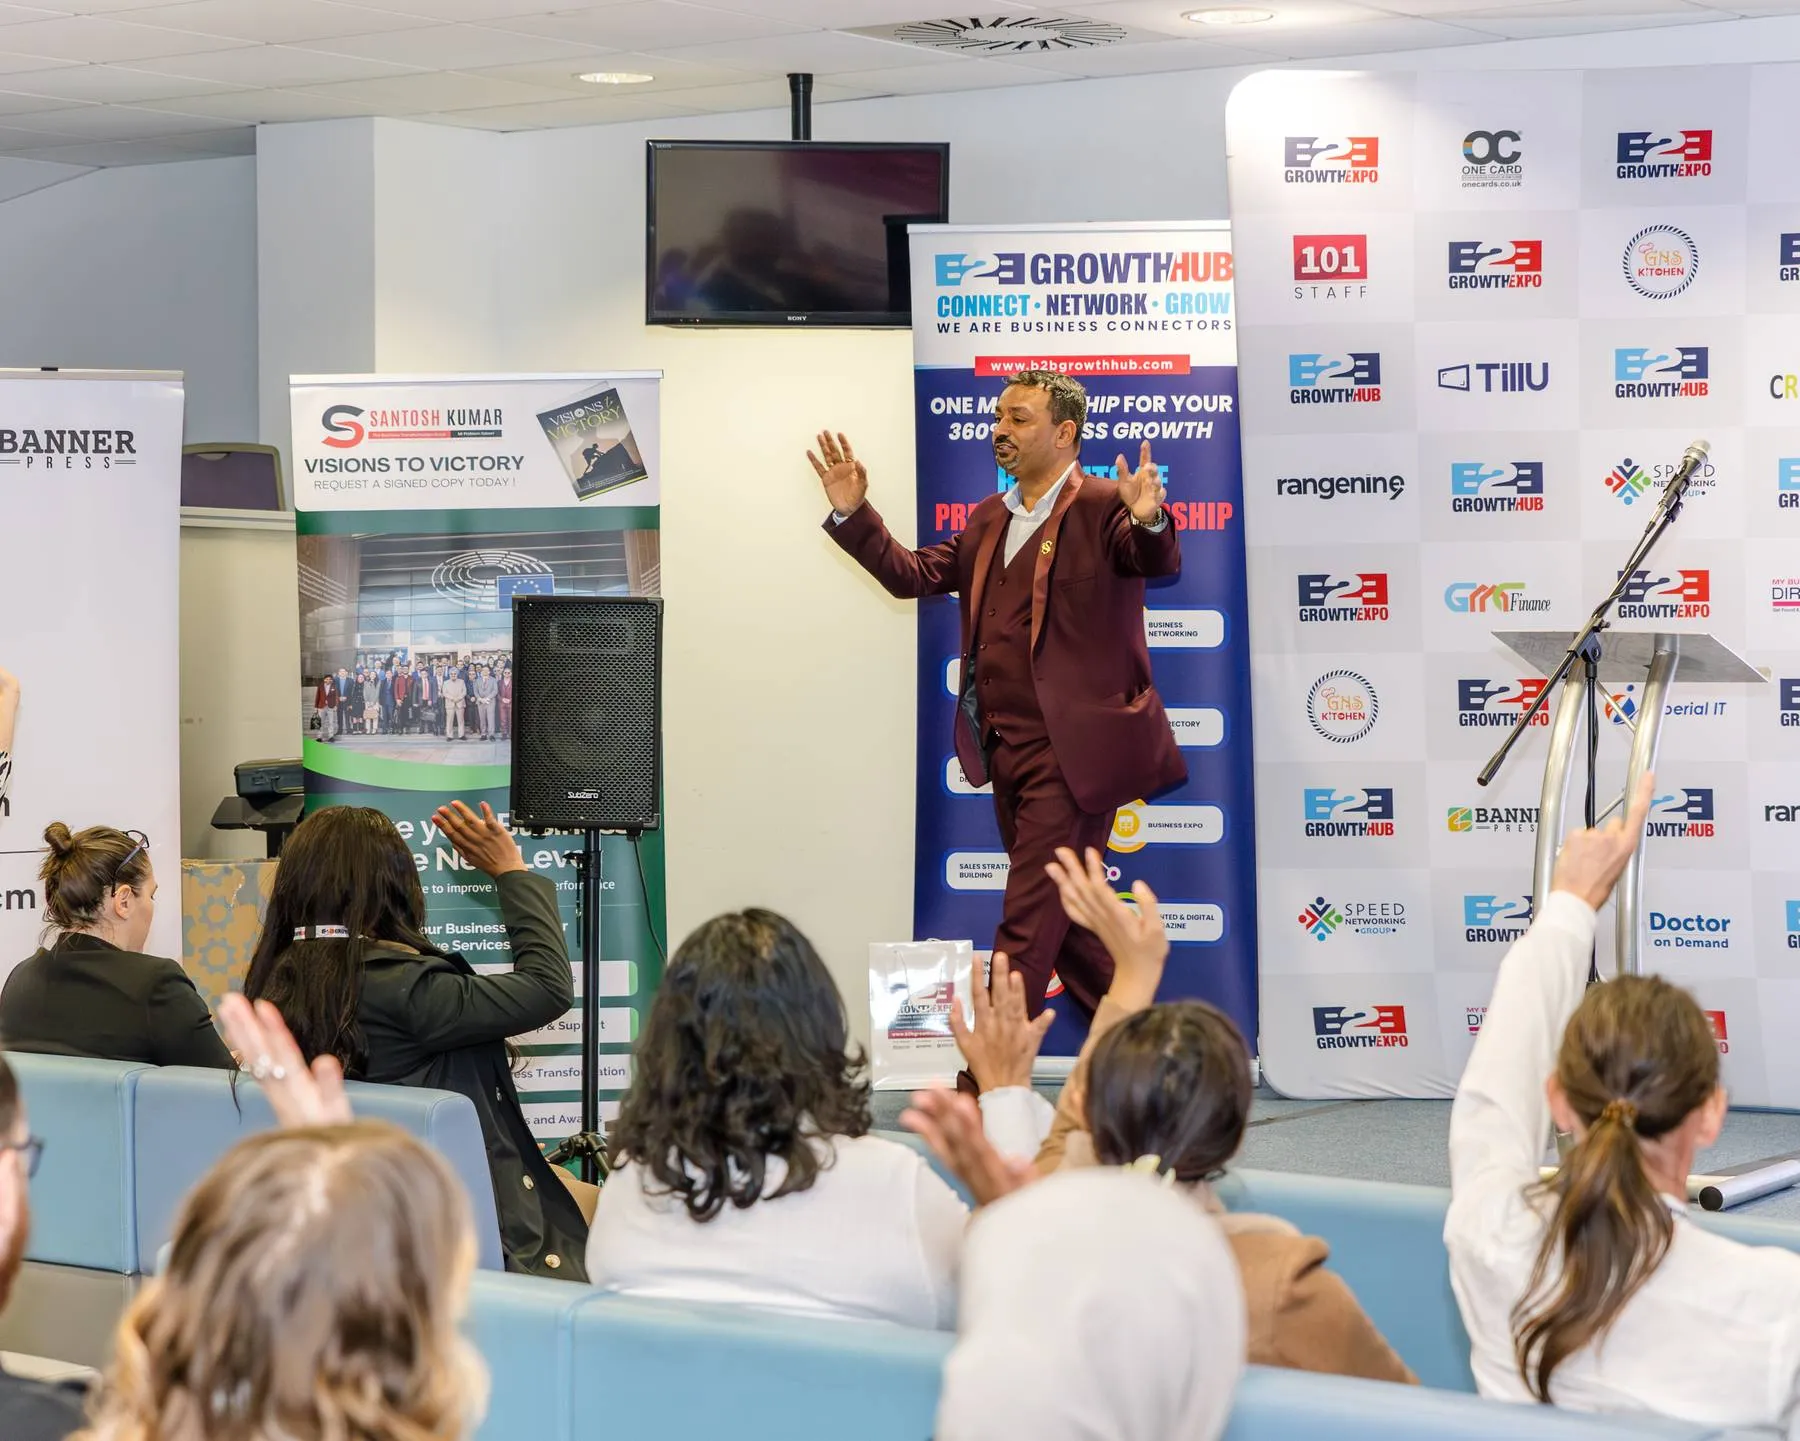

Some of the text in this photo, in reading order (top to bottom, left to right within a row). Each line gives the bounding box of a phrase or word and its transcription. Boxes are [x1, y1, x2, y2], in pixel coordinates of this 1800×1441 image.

[1462, 165, 1522, 175] ONE CARD
[1462, 180, 1521, 188] onecards.co.uk
[1301, 246, 1360, 274] 101
[1294, 285, 1367, 300] STAFF
[937, 291, 1230, 318] CONNECT NETWORK GROW
[937, 319, 1232, 333] WE ARE BUSINESS CONNECTORS
[991, 359, 1174, 373] www.b2bgrowthhub.com
[930, 397, 973, 414] ONE
[1124, 395, 1166, 413] FOR
[1171, 395, 1233, 412] YOUR
[370, 408, 502, 427] SANTOSH KUMAR
[548, 401, 604, 426] VISIONS
[547, 406, 620, 441] VICTORY
[1113, 421, 1214, 439] GROWTH
[0, 429, 136, 454] BANNER
[27, 456, 110, 468] PRESS
[304, 455, 524, 473] VISIONS TO VICTORY
[1653, 464, 1715, 478] SPD
[314, 479, 370, 491] REQUEST
[372, 480, 382, 489] A
[384, 479, 428, 489] SIGNED
[431, 478, 467, 488] COPY
[469, 477, 511, 488] TODAY
[1510, 592, 1551, 612] Finance
[1148, 621, 1183, 629] BUSINESS
[1713, 702, 1727, 715] IT
[567, 790, 600, 799] SubZero
[1494, 824, 1535, 833] PRES
[432, 885, 443, 894] to
[447, 883, 492, 896] improve
[1345, 904, 1405, 916] SPEED
[446, 922, 506, 934] Business
[1650, 912, 1730, 932] Doctor
[1360, 927, 1391, 935] GROUP
[452, 939, 511, 951] Services
[1654, 936, 1729, 949] on Demand
[534, 1115, 556, 1125] and
